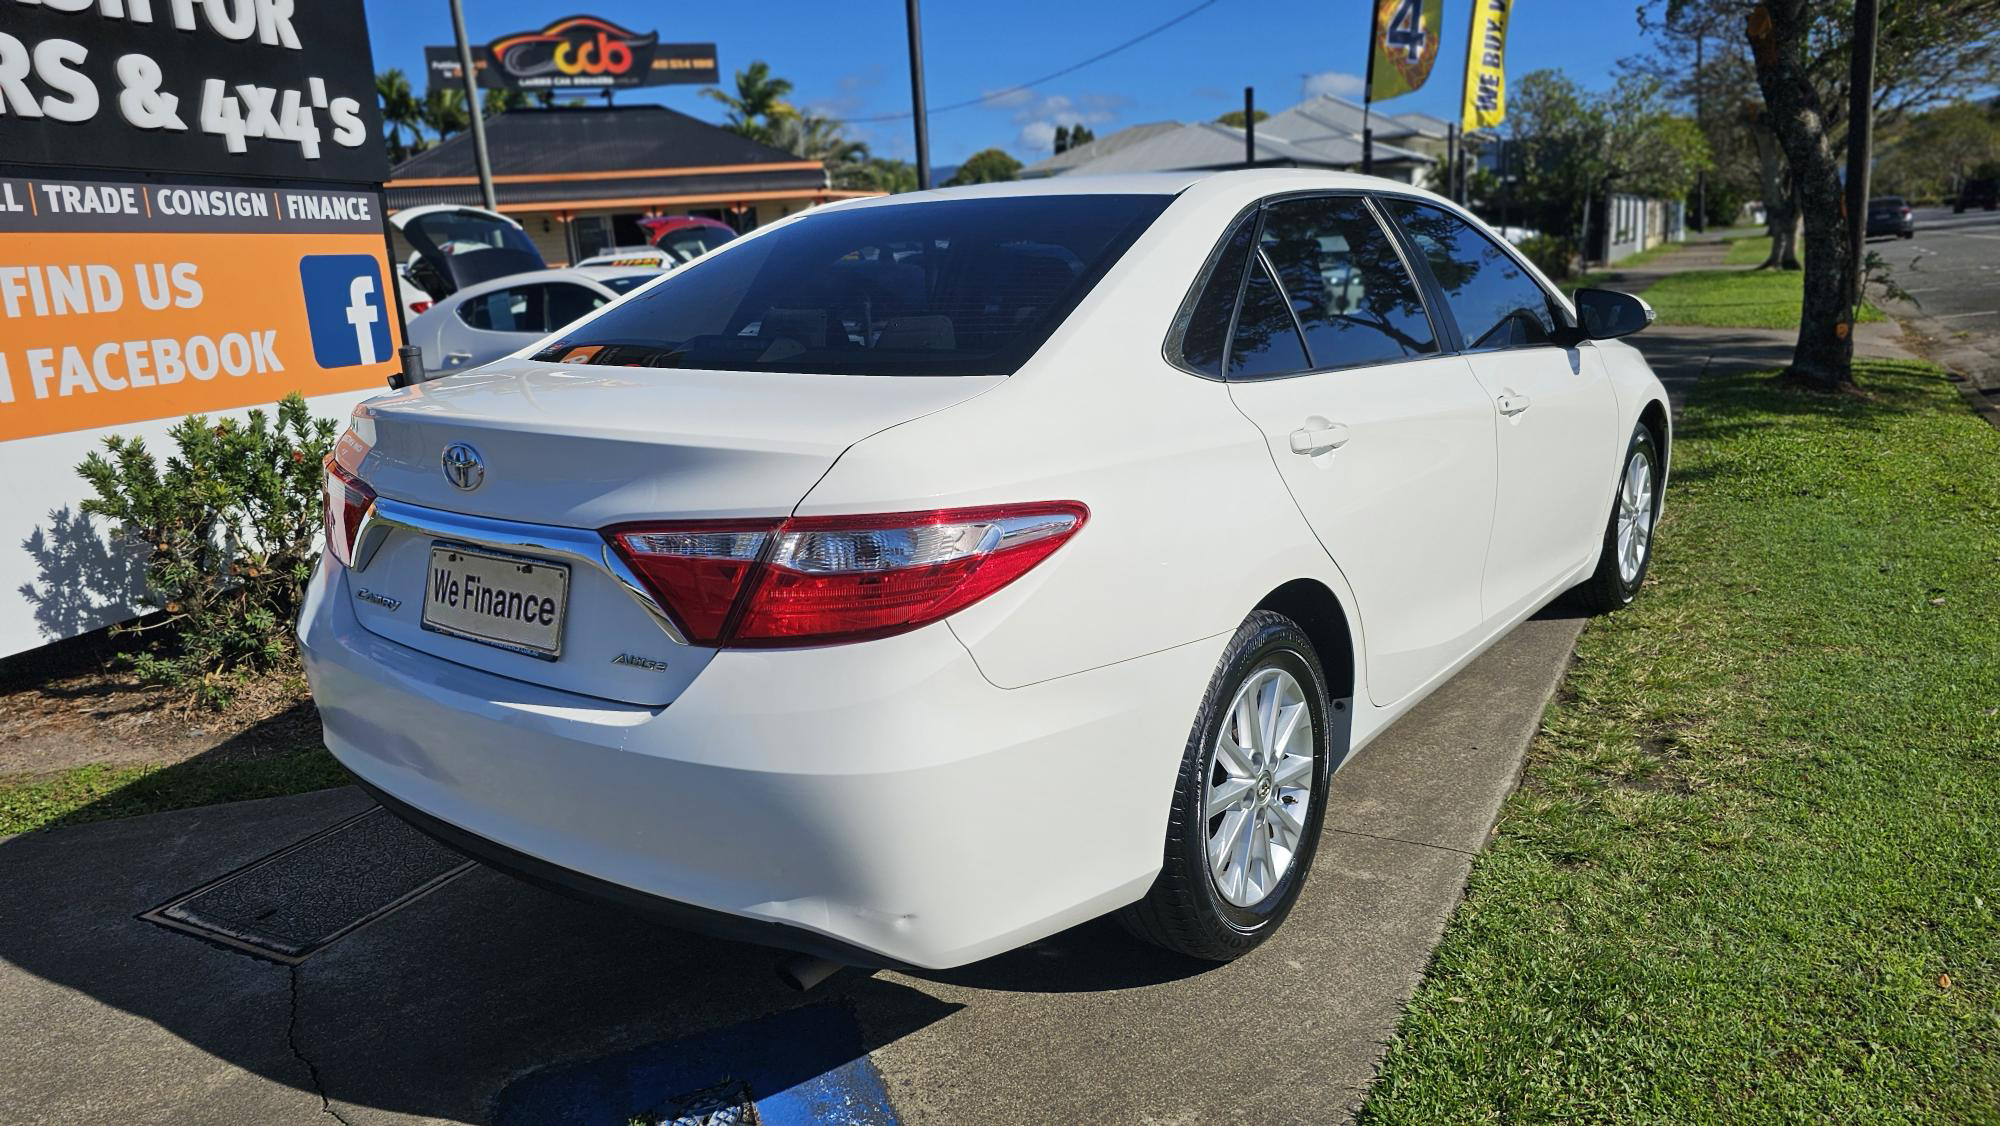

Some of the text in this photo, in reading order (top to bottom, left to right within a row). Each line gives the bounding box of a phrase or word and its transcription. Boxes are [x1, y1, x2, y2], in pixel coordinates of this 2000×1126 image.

[117, 54, 188, 129] &
[1476, 73, 1500, 111] WE
[42, 185, 138, 214] TRADE
[157, 189, 269, 217] CONSIGN
[286, 195, 371, 220] FINANCE
[0, 262, 204, 318] FIND US
[26, 330, 285, 399] FACEBOOK
[433, 567, 556, 627] We Finance
